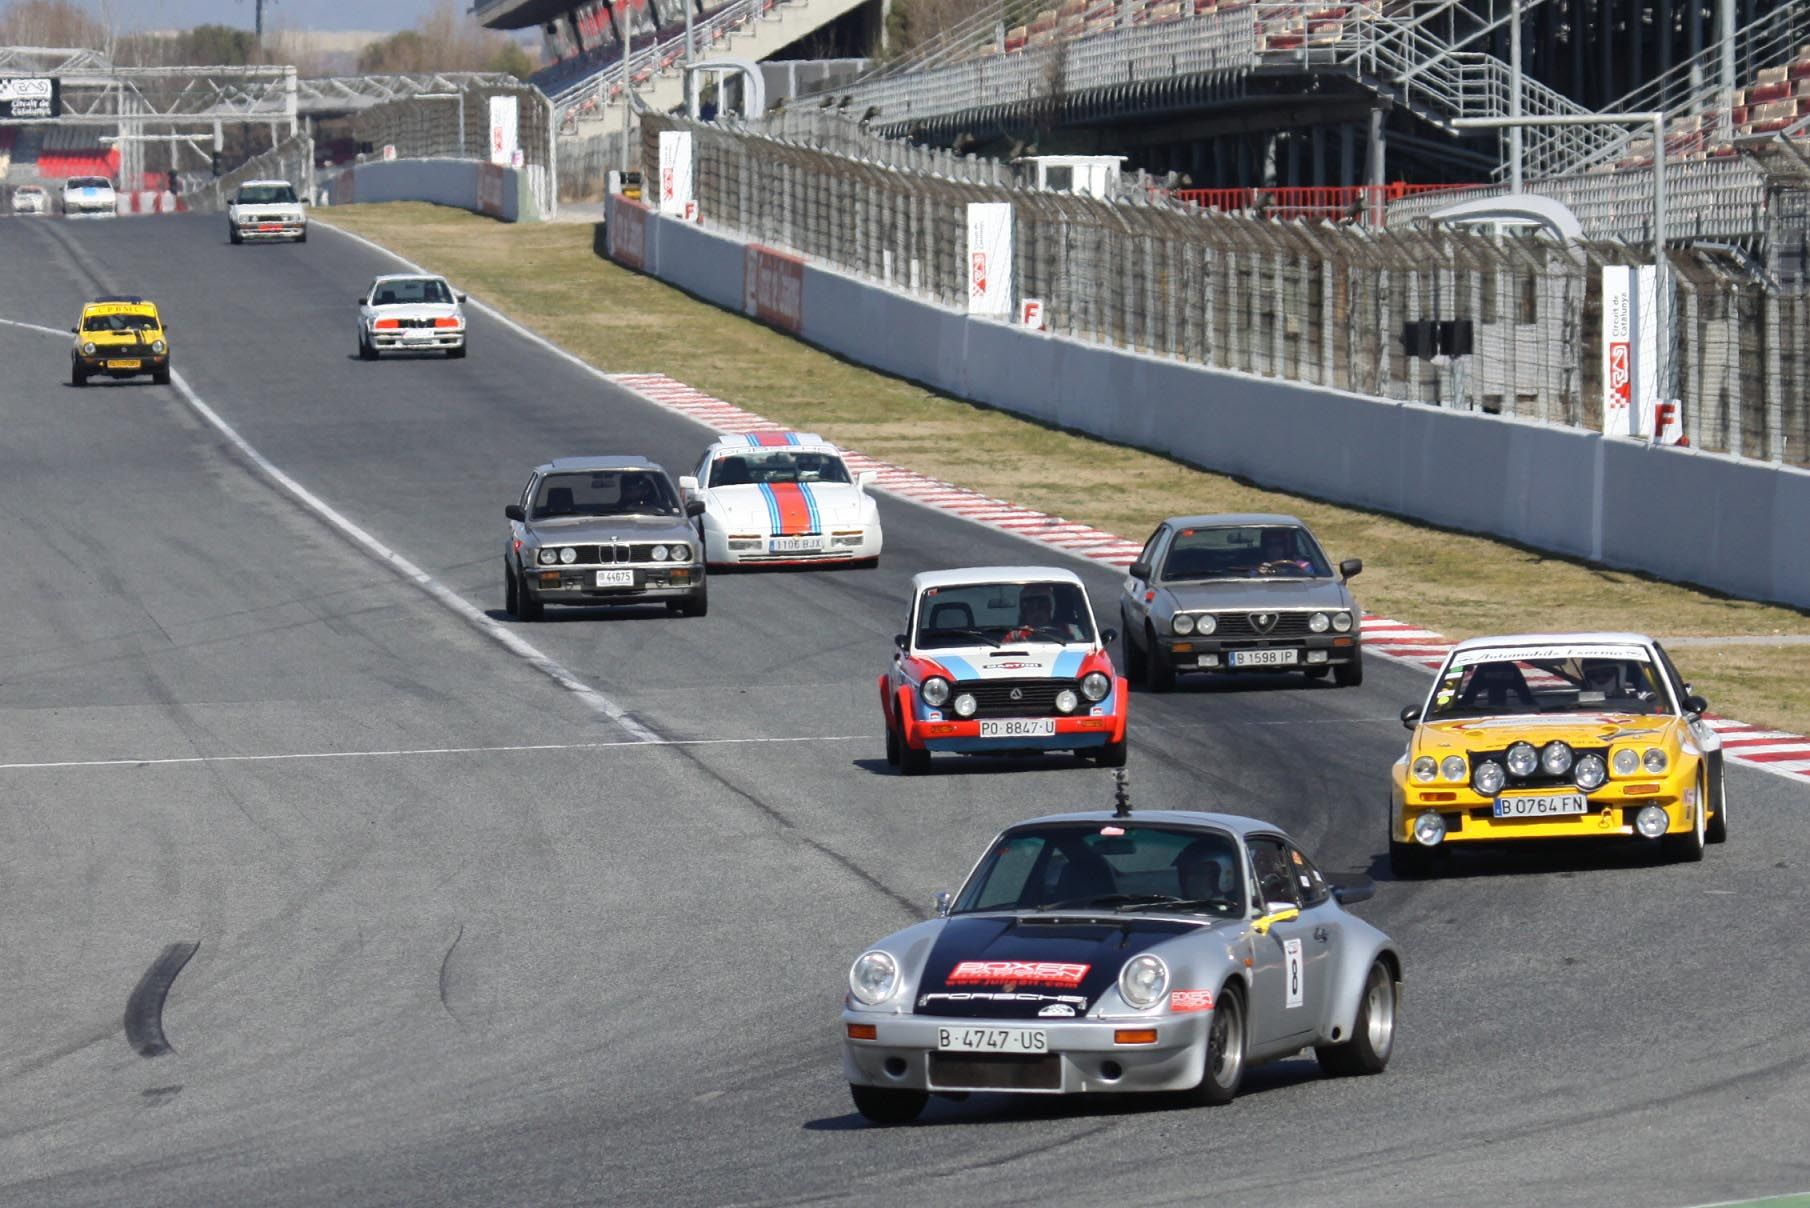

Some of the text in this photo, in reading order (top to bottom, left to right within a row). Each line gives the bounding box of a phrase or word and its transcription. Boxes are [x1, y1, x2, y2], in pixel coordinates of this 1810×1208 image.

[685, 203, 694, 219] F
[1024, 303, 1039, 324] F
[1612, 295, 1620, 337] Circuit de
[1620, 292, 1629, 337] Catalunya
[1655, 404, 1675, 437] F
[1236, 651, 1293, 664] B 1598 IP
[1501, 796, 1583, 815] B 0764 FN
[1291, 958, 1298, 996] 8
[926, 992, 1086, 1003] PORSCHE
